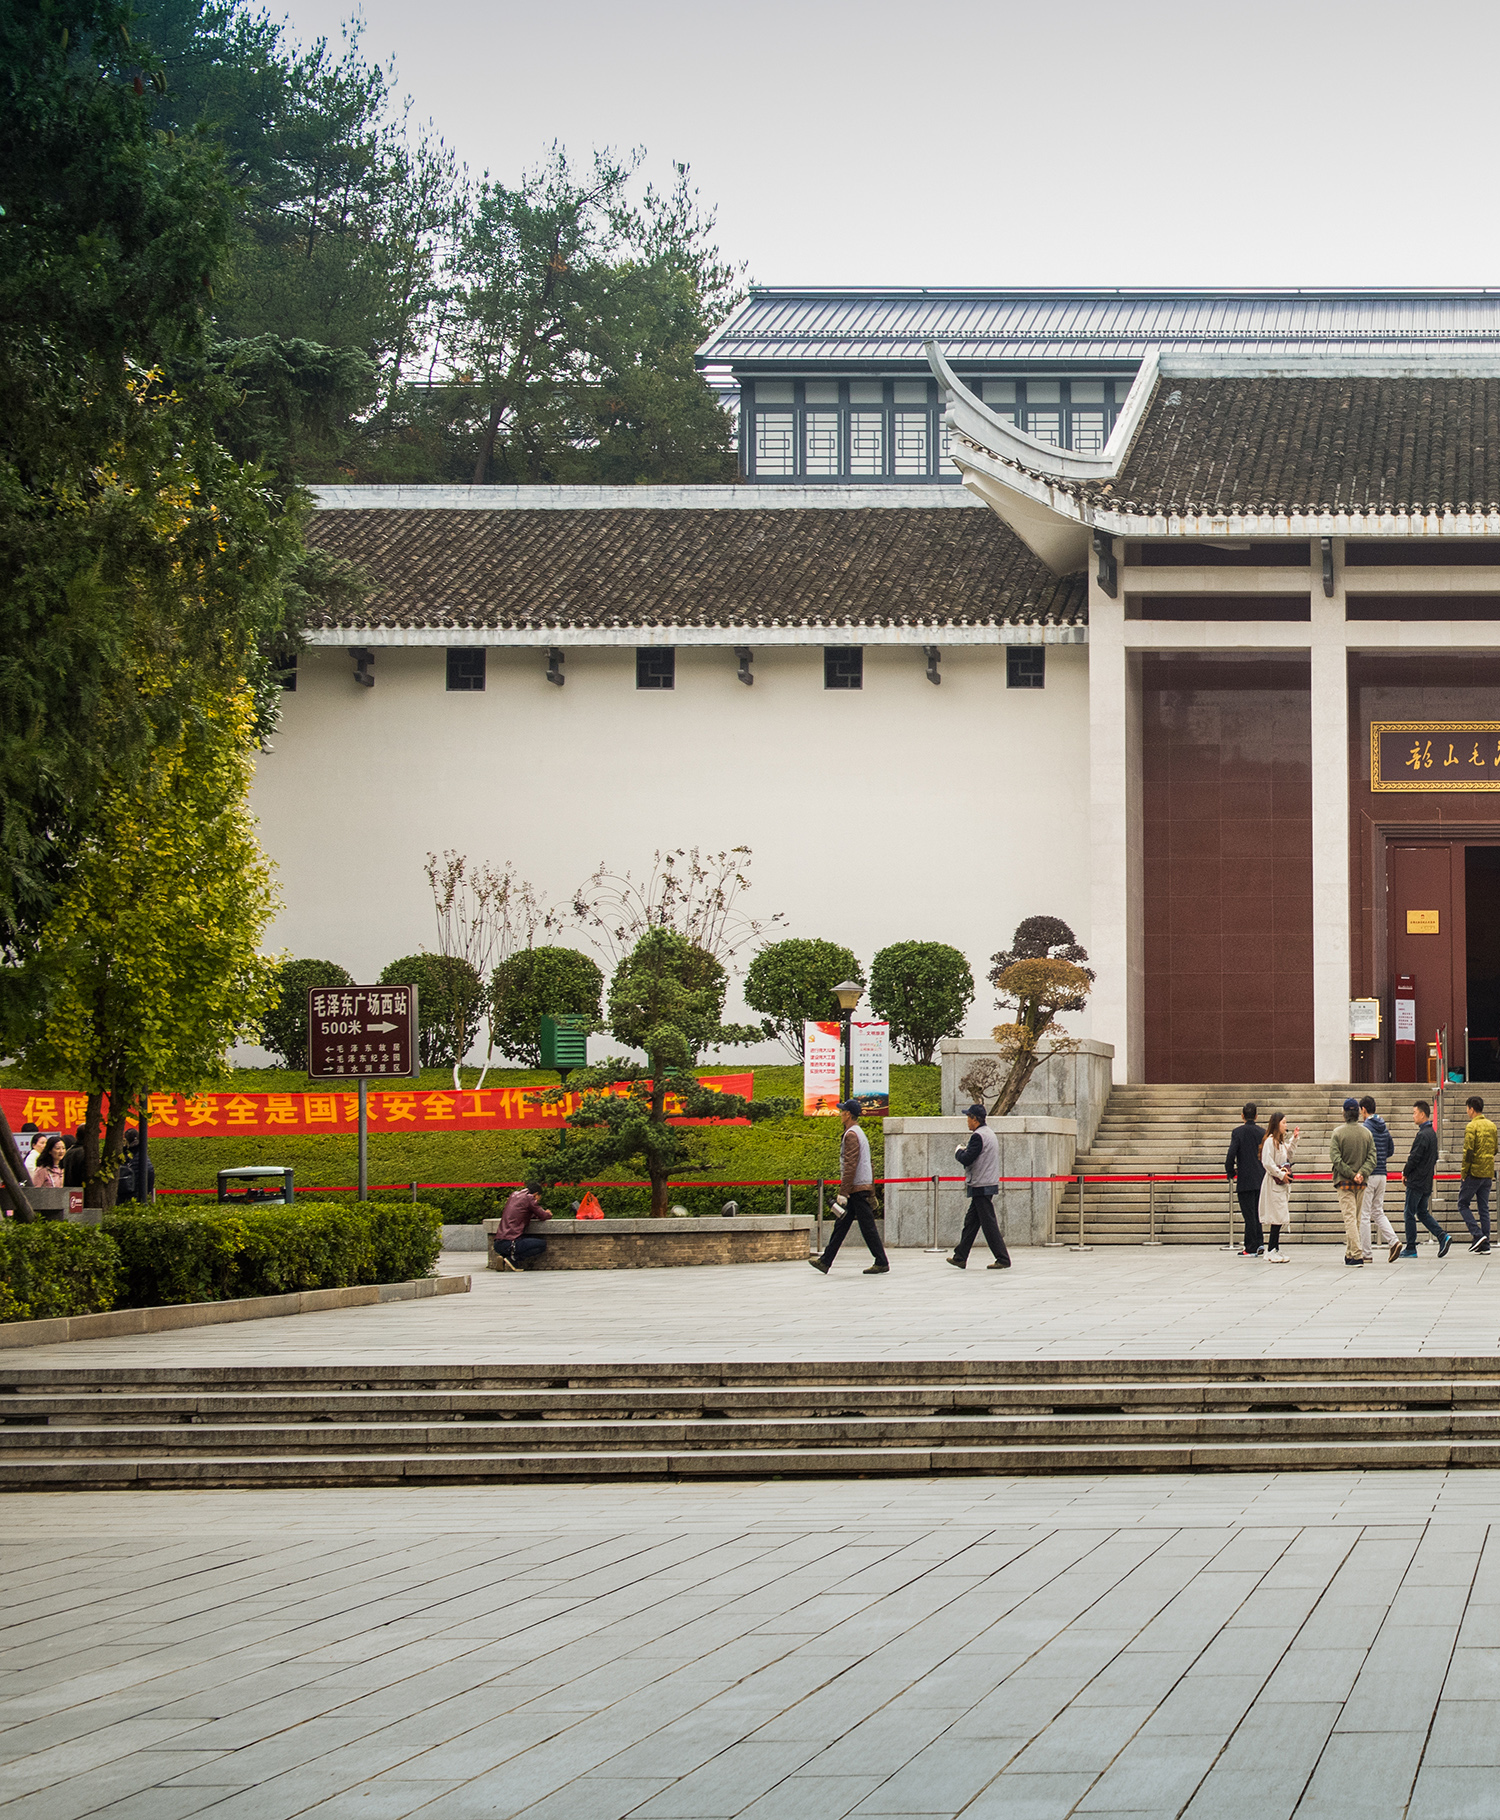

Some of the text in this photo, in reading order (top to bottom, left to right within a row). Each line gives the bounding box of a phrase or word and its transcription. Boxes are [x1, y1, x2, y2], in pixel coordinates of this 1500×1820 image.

[313, 992, 407, 1018] 毛泽东广场西站
[321, 1019, 362, 1035] 500米
[336, 1043, 400, 1053] 毛泽东故居
[336, 1053, 400, 1064] 毛泽东纪念园
[336, 1063, 400, 1073] 滴水洞景区
